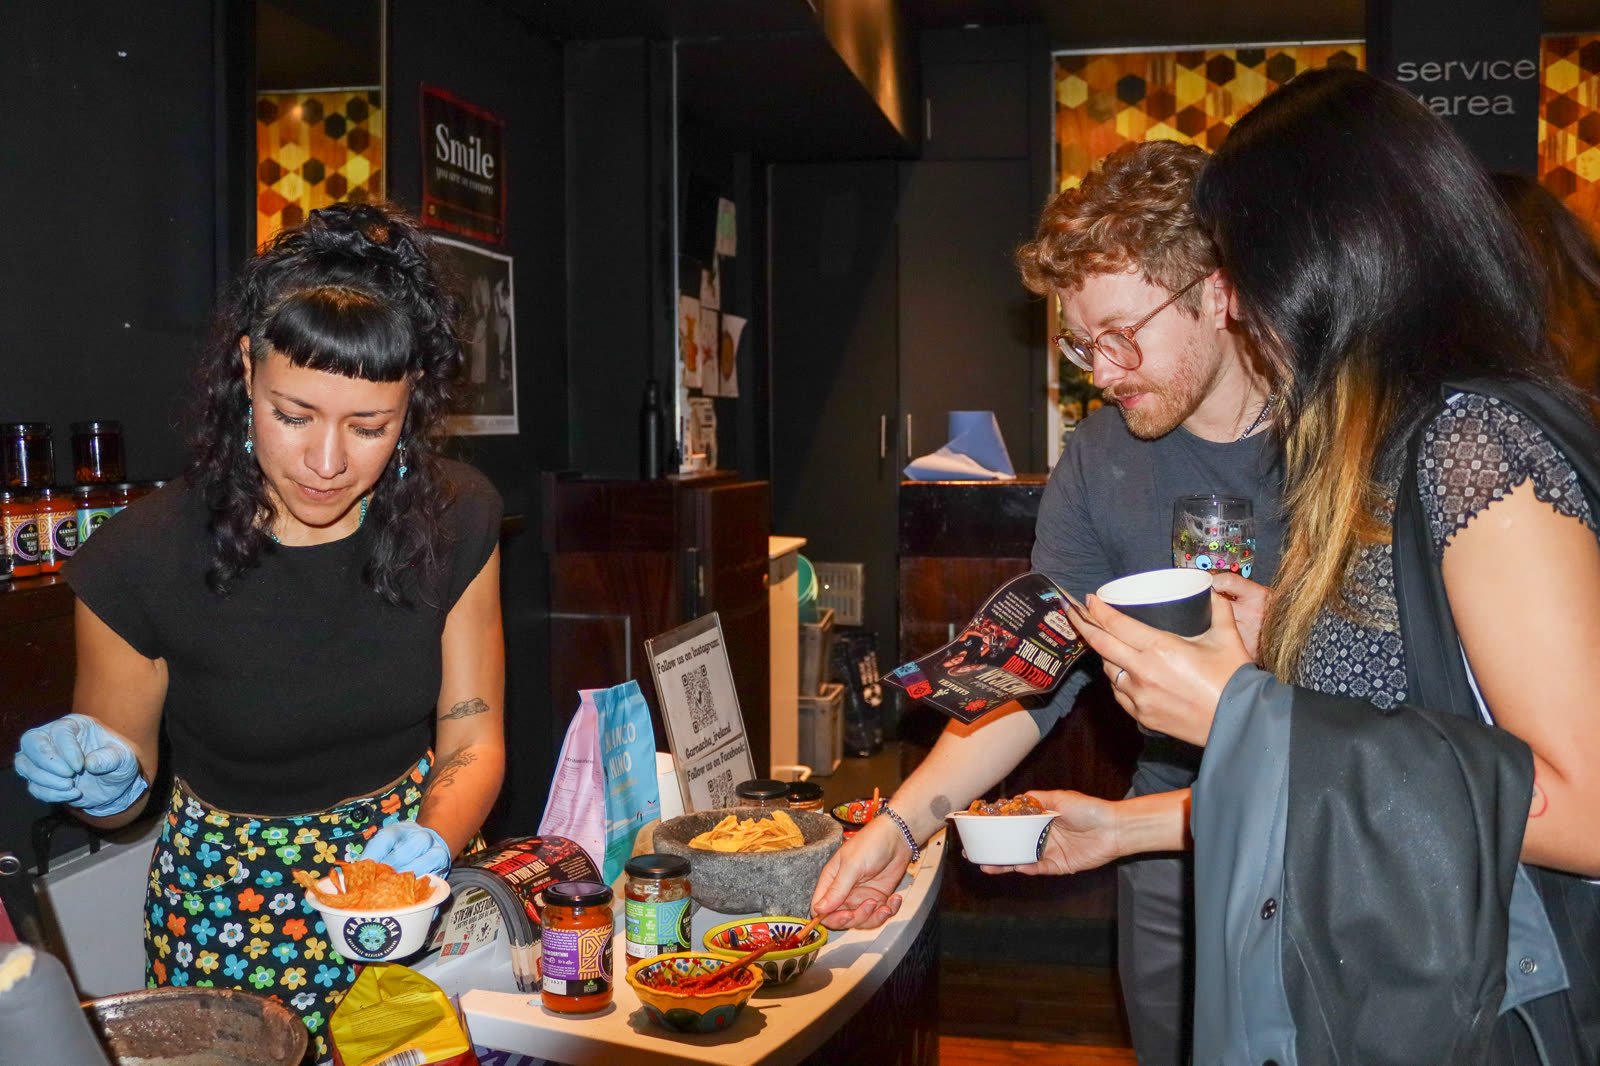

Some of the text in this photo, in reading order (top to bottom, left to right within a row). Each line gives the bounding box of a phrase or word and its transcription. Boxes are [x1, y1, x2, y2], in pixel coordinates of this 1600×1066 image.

[1396, 59, 1536, 82] service
[1428, 95, 1516, 116] area
[435, 123, 494, 180] Smile
[656, 660, 676, 674] Follow
[677, 656, 684, 665] us
[685, 652, 692, 661] on
[1016, 639, 1062, 676] TO YOUR TABLE
[975, 668, 1036, 695] MEXICAN
[1002, 655, 1053, 688] STREET FOOD
[687, 766, 705, 782] Follow
[706, 762, 713, 771] us
[713, 758, 721, 767] on
[504, 873, 520, 885] TO
[512, 866, 535, 881] YOUR
[526, 859, 550, 874] TABLE
[346, 917, 400, 938] GARNACHA
